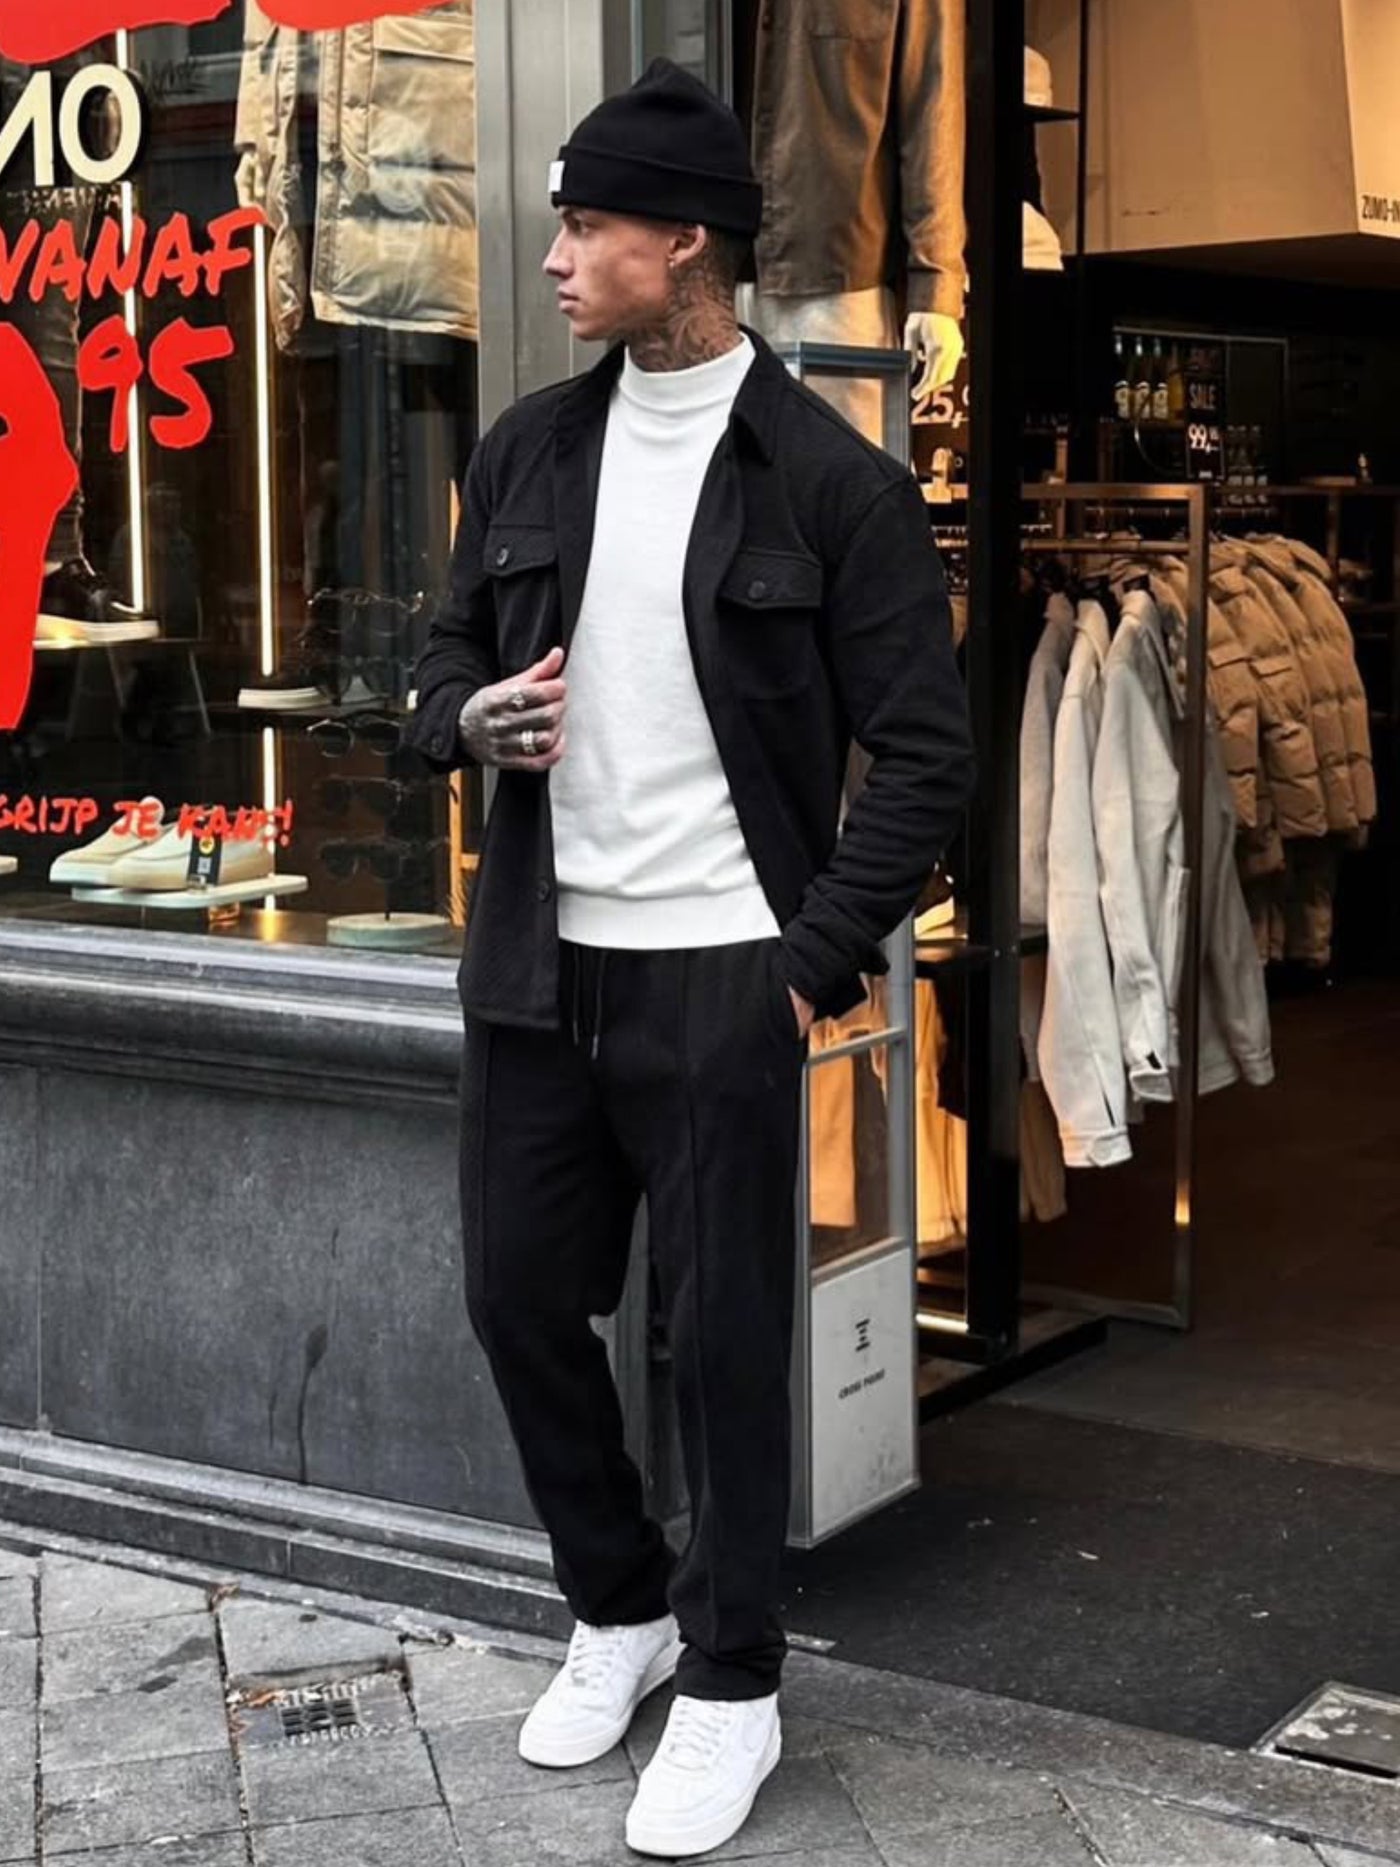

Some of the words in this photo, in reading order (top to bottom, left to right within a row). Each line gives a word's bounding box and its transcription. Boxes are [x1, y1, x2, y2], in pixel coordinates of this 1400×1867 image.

[0, 204, 268, 303] VANAF
[78, 315, 234, 453] 95
[1190, 382, 1217, 409] SALE
[113, 801, 164, 839] JE
